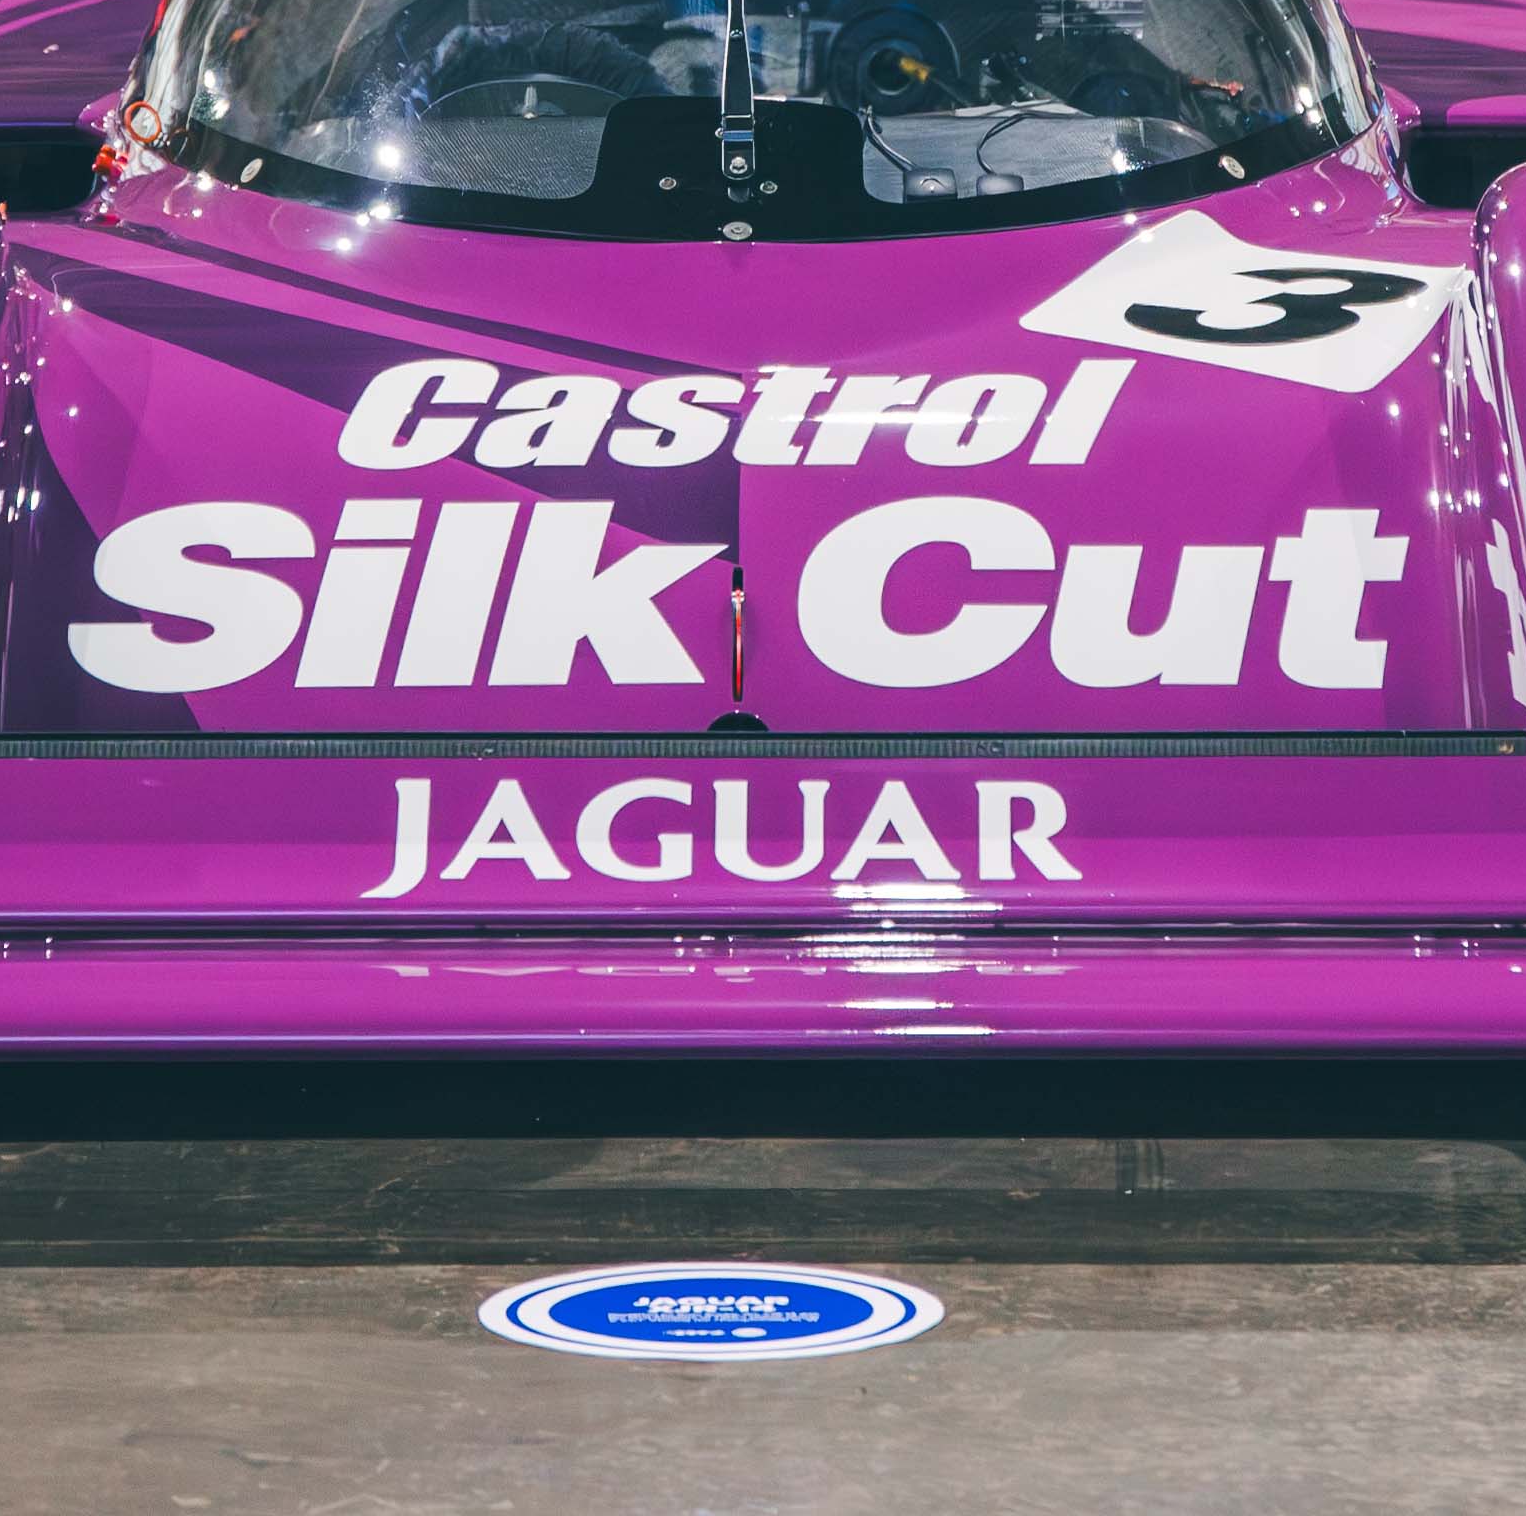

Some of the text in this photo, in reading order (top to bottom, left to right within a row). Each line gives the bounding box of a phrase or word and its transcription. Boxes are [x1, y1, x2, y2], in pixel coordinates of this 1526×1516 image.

[1124, 268, 1429, 345] 3
[337, 358, 1137, 470] Castrol
[67, 498, 730, 694] Silk
[797, 496, 1411, 690] Cut
[359, 777, 1083, 899] JAGUAR
